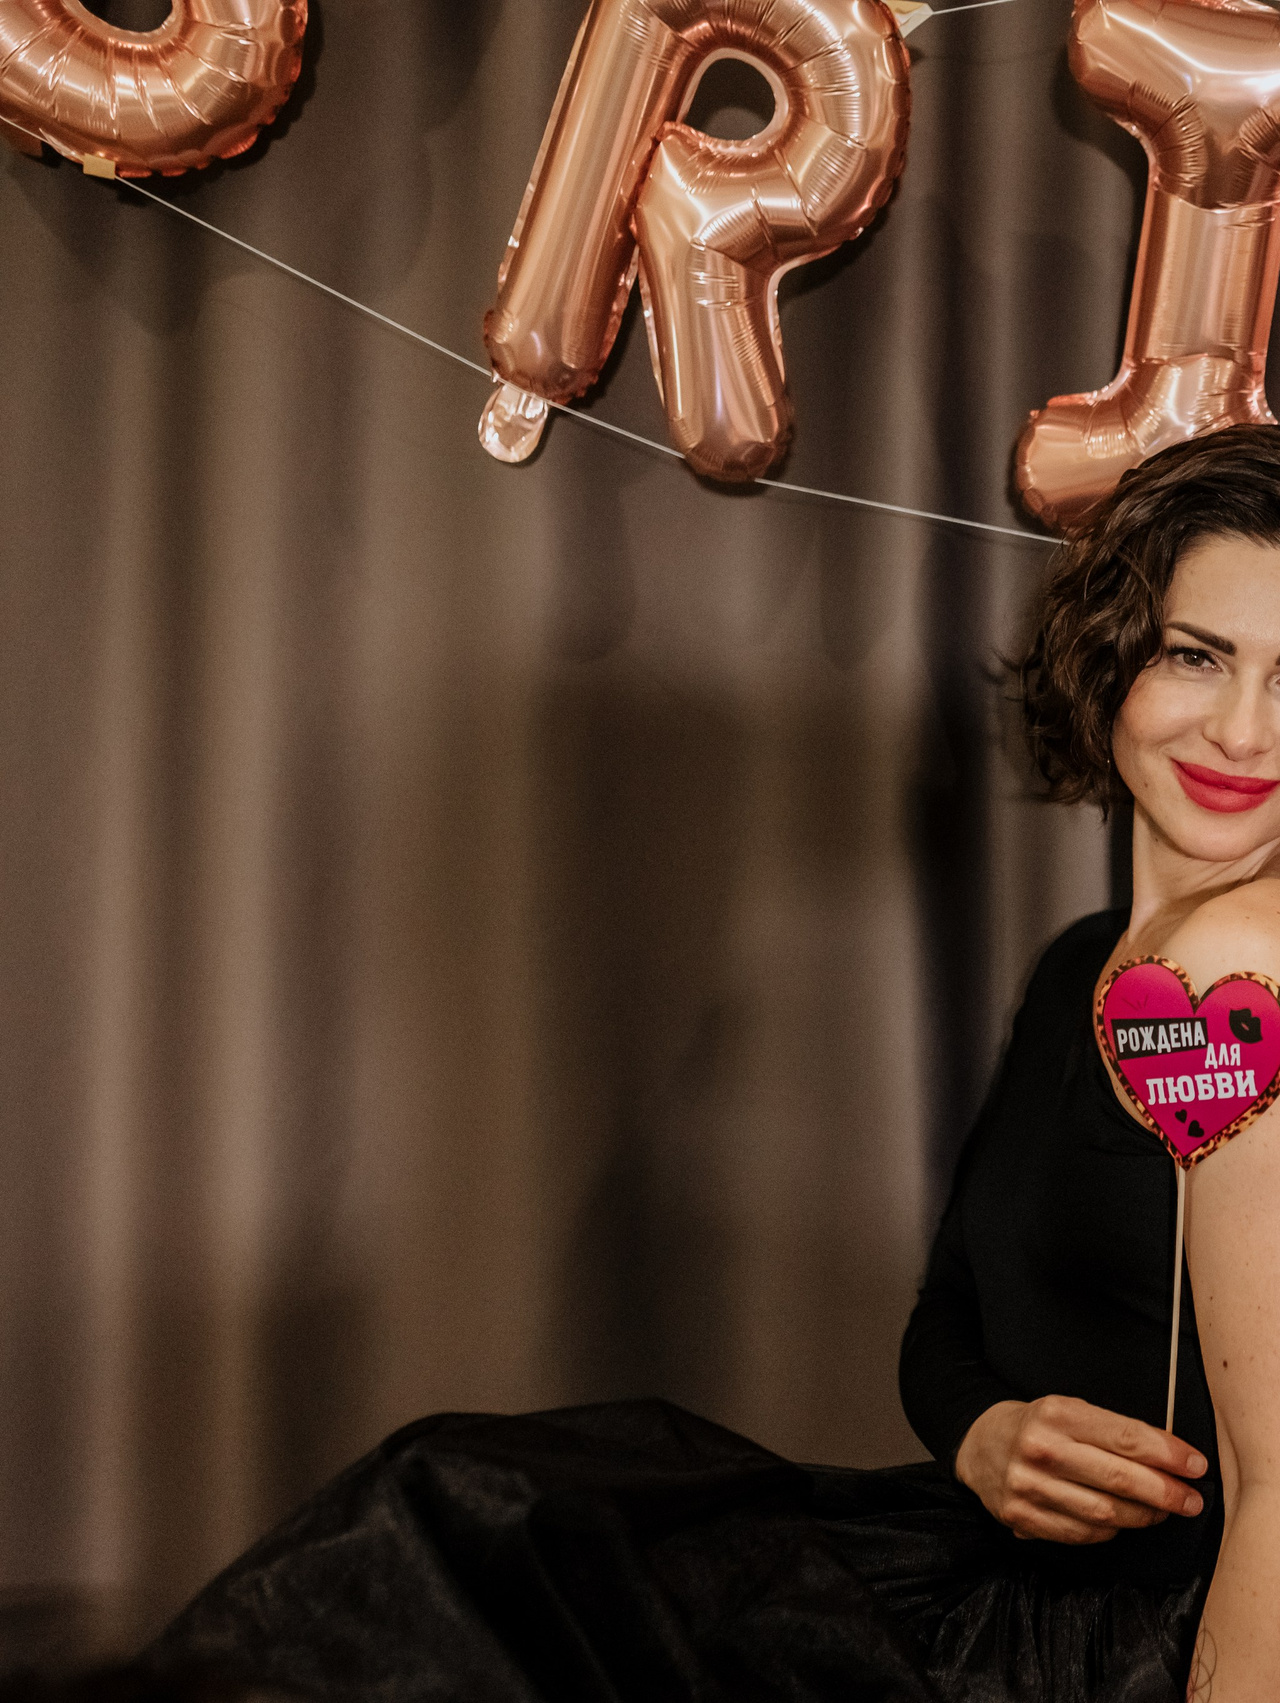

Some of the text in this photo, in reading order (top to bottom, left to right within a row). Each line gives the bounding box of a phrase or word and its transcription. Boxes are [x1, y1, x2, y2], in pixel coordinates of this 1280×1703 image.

[1116, 1021, 1206, 1053] РОЖДЕНА
[1204, 1043, 1241, 1069] ДЛЯ
[1146, 1069, 1258, 1106] ЛЮБВИ
